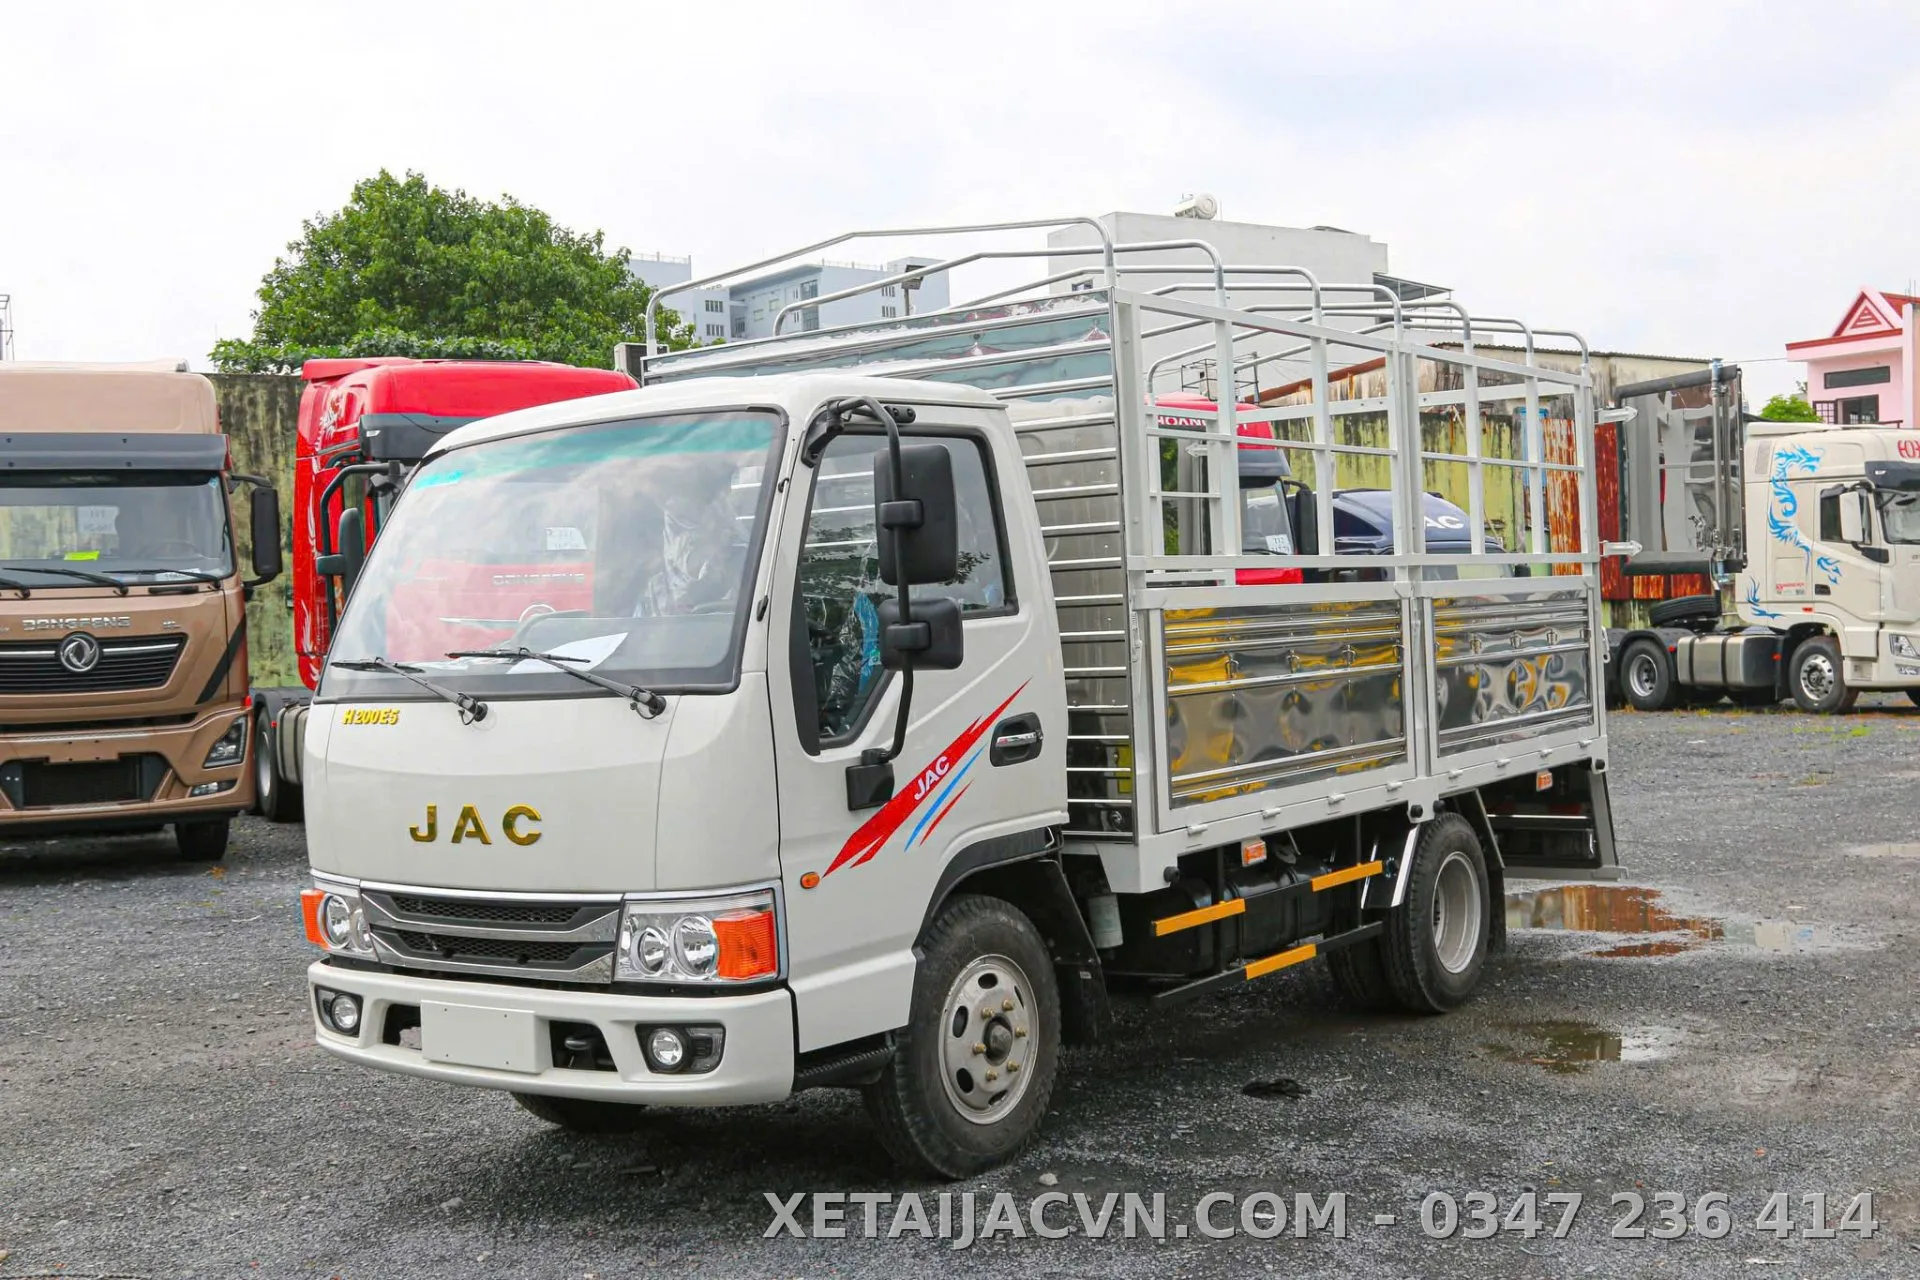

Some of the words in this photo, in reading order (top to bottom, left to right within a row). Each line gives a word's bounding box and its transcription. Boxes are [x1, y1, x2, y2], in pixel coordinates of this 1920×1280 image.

[1158, 415, 1207, 426] HOAN
[1424, 515, 1464, 529] AC
[343, 708, 400, 725] H200E5
[914, 755, 950, 800] JAC
[409, 802, 542, 846] JAC
